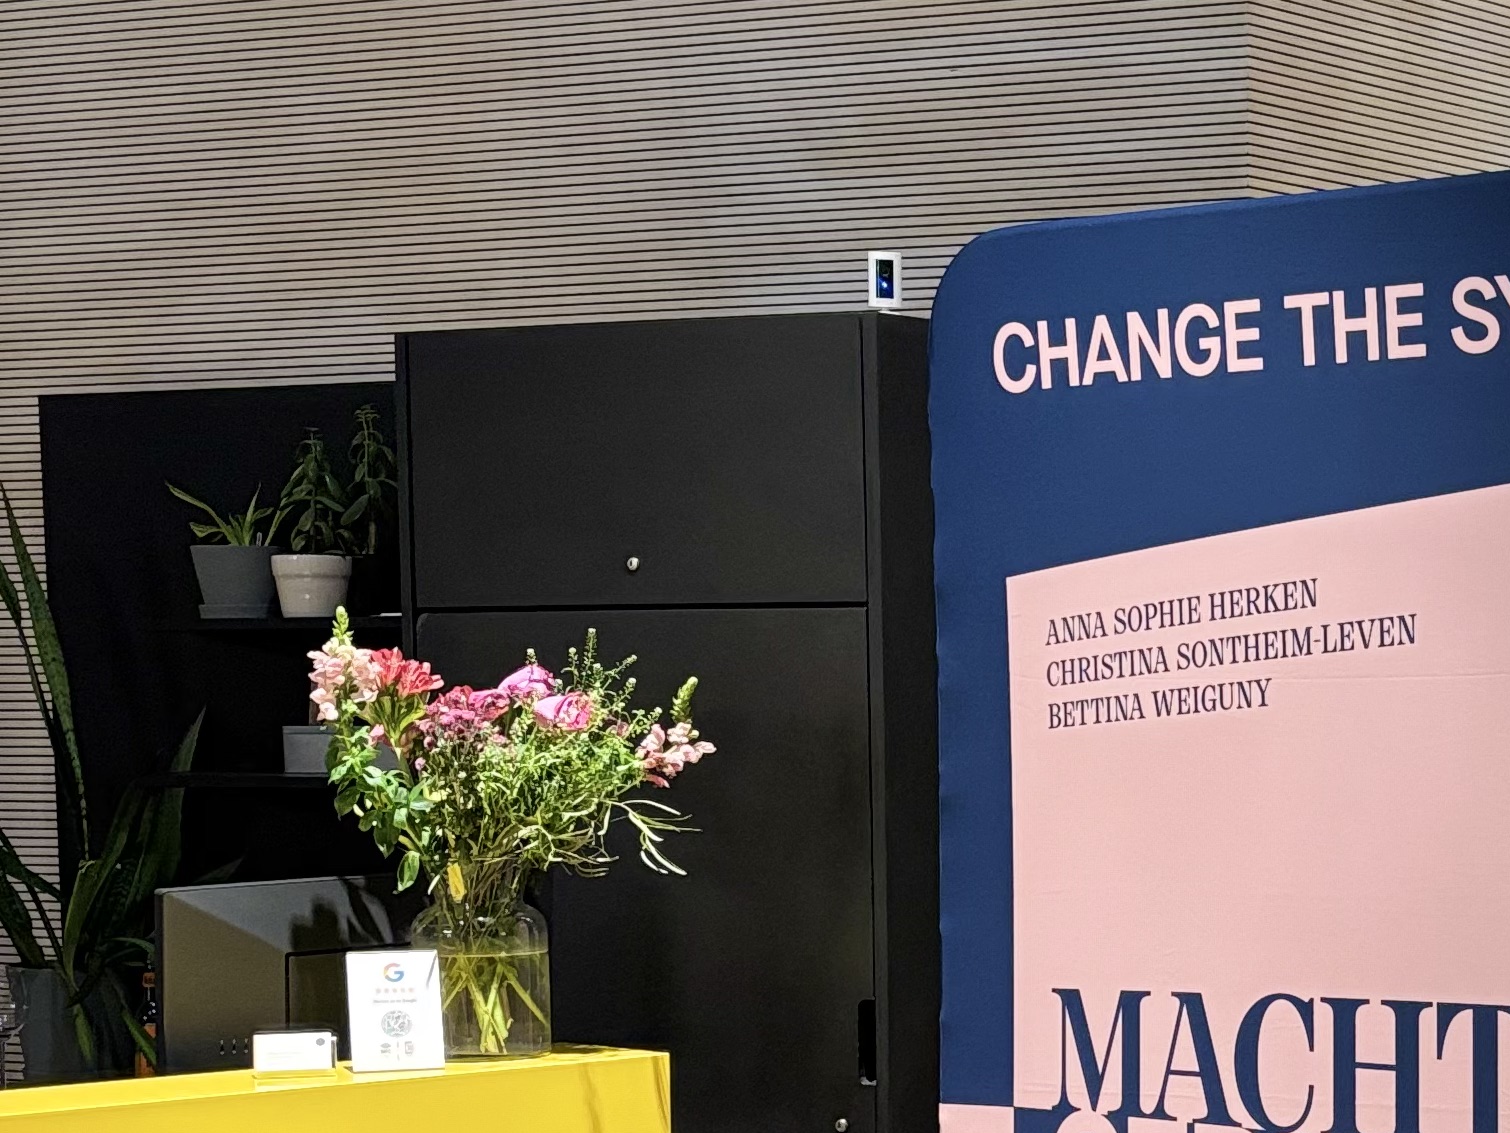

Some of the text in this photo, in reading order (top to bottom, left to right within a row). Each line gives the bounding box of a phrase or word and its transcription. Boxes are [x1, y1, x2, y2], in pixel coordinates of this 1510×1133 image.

[993, 298, 1264, 394] CHANGE
[1284, 283, 1427, 367] THE
[1045, 578, 1318, 646] ANNA SOPHIE HERKEN
[1046, 613, 1417, 687] CHRISTINA SONTHEIM-LEVEN
[1048, 678, 1272, 729] BETTINA WEIGUNY
